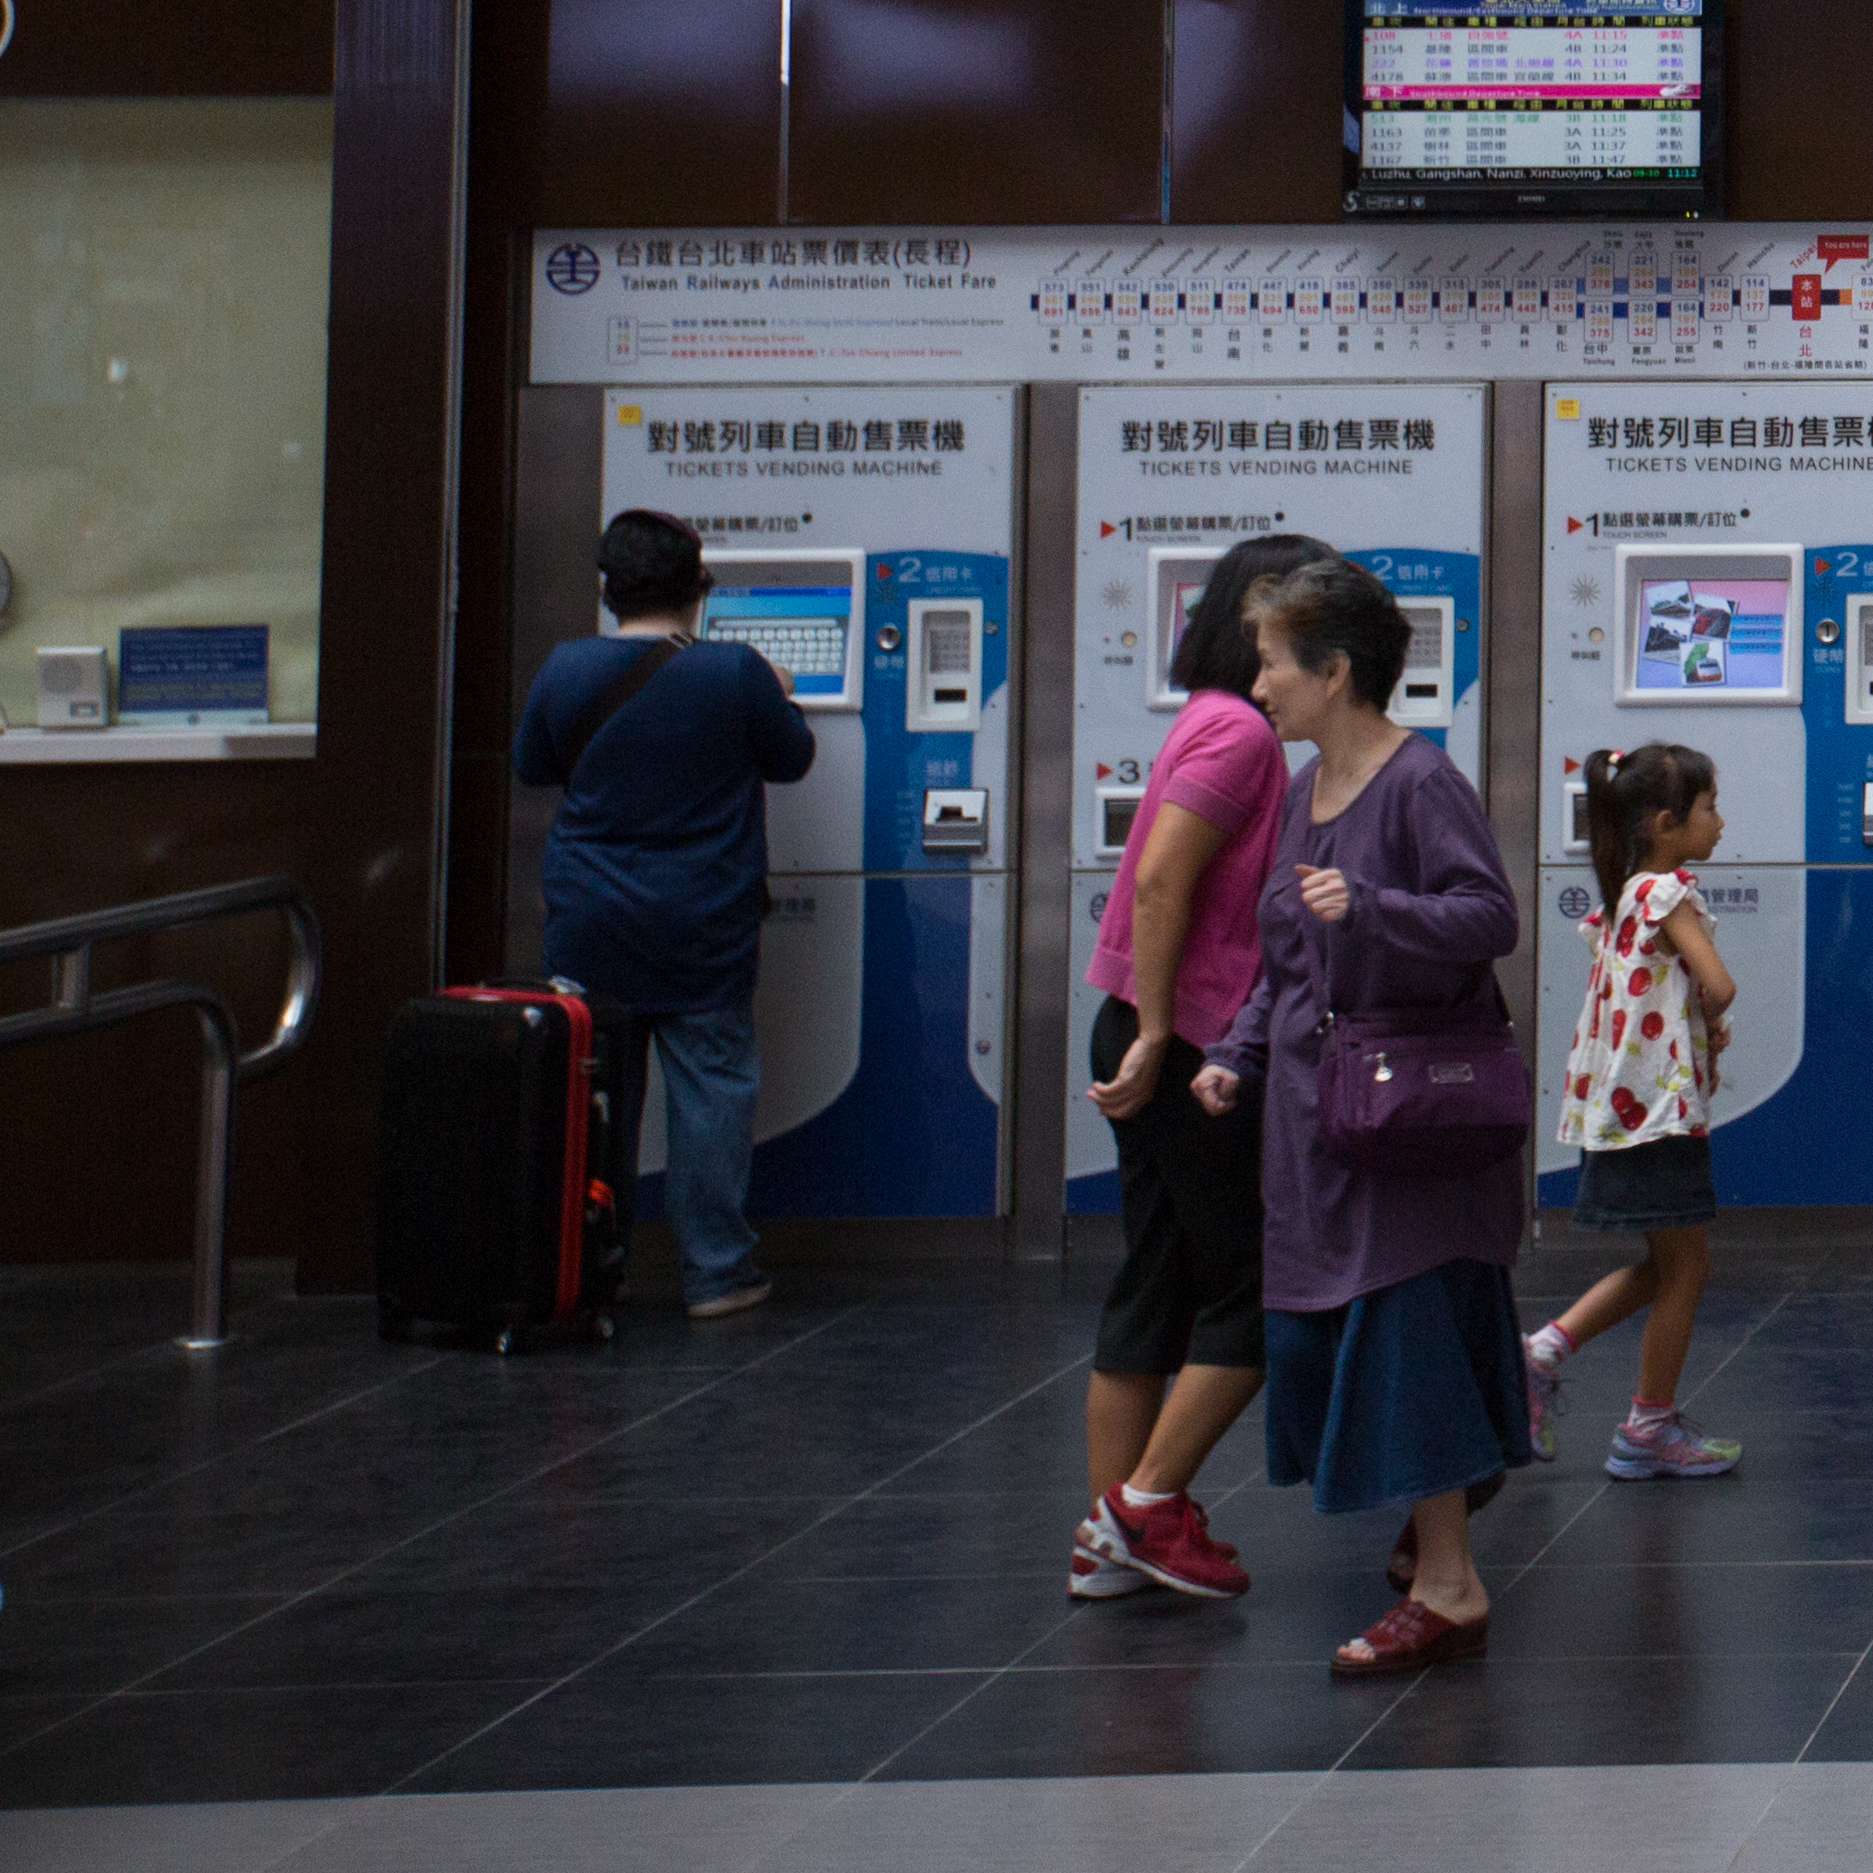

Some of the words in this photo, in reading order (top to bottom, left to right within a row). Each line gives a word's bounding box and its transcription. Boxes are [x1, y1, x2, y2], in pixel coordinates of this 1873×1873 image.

[621, 275, 678, 292] Taiwan
[687, 275, 761, 293] Railways
[769, 274, 891, 292] Administration
[903, 274, 953, 290] Ticket
[961, 274, 997, 290] Fare
[1799, 326, 1812, 357] 台北
[647, 420, 965, 454] 對號列車自動售票機
[1121, 419, 1435, 453] 對號列車自動售票機
[666, 461, 748, 477] TICKETS
[757, 461, 845, 477] VENDING
[853, 460, 943, 476] MACHINE
[1140, 460, 1221, 476] TICKETS
[1230, 460, 1317, 476] VENDING
[1325, 458, 1413, 475] MACHINE
[1606, 457, 1688, 472] TICKETS
[1694, 457, 1782, 471] VENDING
[1119, 518, 1133, 541] 1
[1585, 512, 1600, 537] 1
[898, 557, 921, 583] 2
[1371, 556, 1393, 581] 2
[1836, 552, 1858, 577] 2
[1118, 760, 1140, 784] 3
